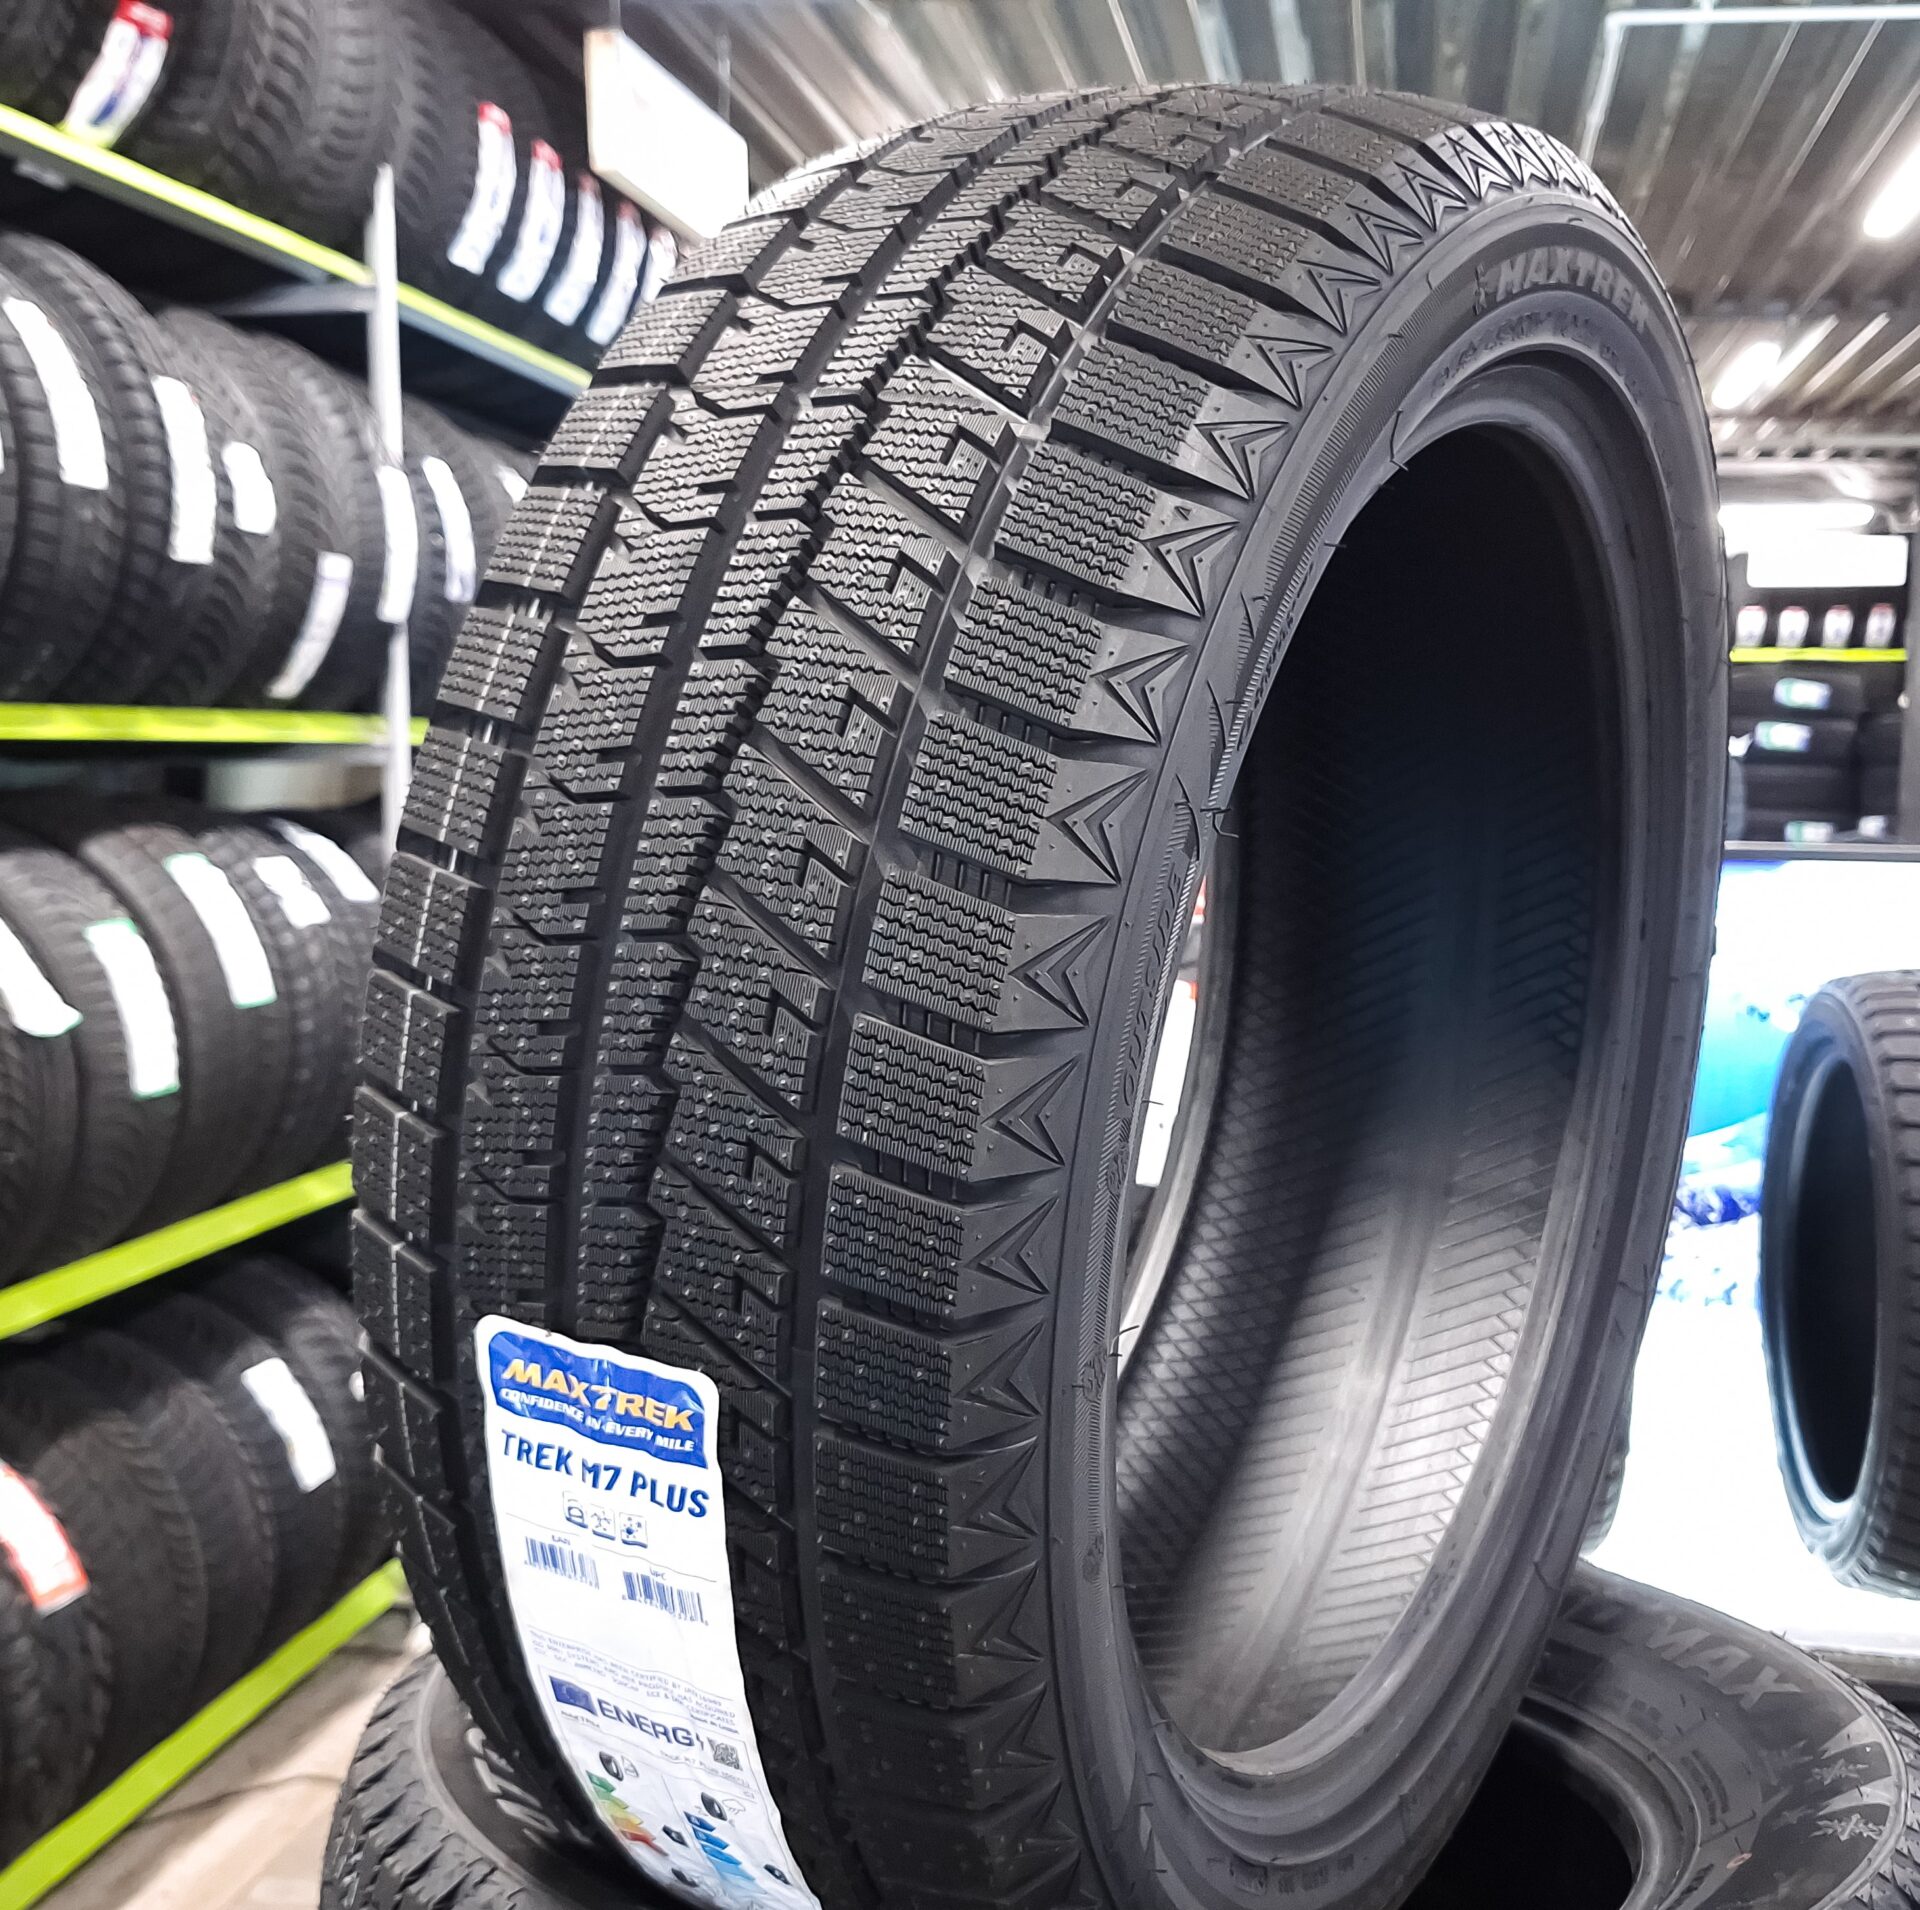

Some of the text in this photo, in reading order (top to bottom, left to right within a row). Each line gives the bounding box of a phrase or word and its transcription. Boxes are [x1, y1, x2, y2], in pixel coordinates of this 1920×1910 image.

[1496, 246, 1651, 333] MAXTREK
[500, 1387, 695, 1452] CONFIDENCE IN EVERY MILE
[501, 1358, 695, 1432] MAXTREK
[501, 1429, 710, 1519] TREK M7 PLUS
